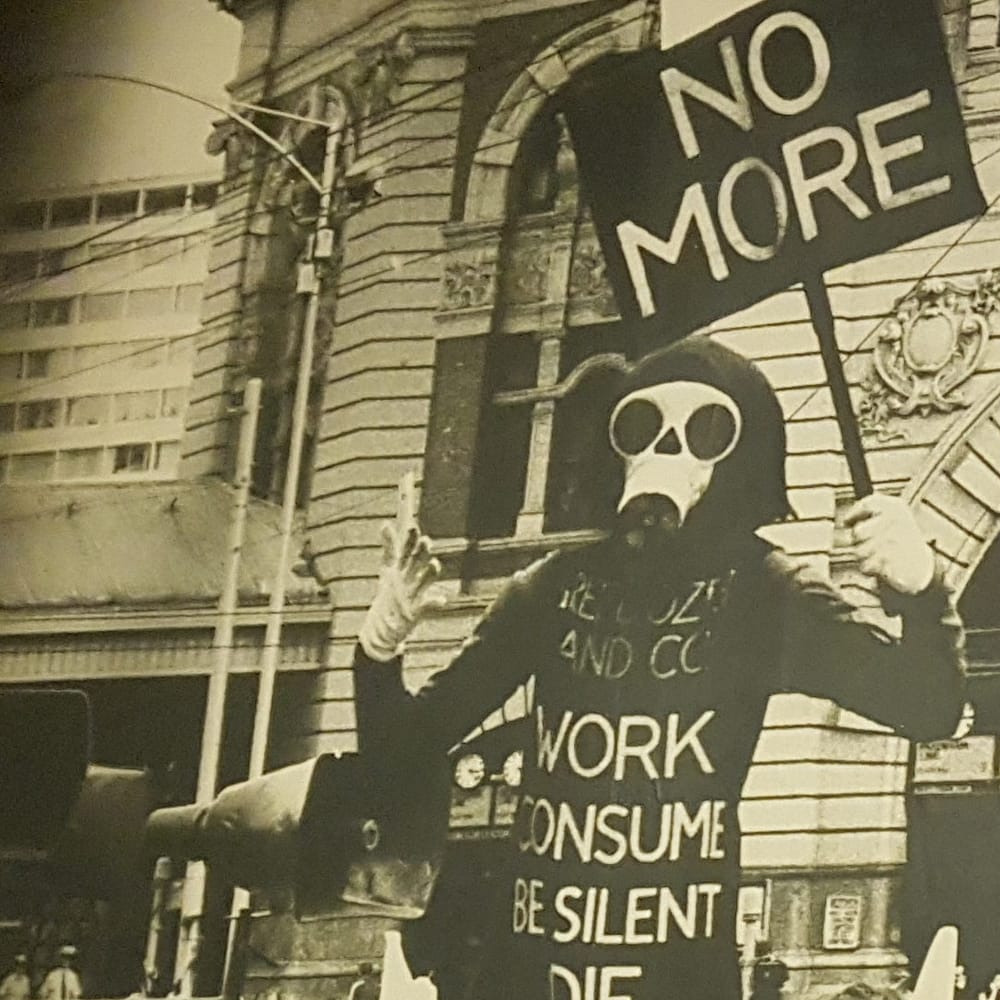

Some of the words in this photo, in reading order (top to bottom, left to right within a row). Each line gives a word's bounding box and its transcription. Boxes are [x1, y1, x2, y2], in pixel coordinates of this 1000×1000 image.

[660, 10, 831, 159] NO
[616, 89, 951, 318] MORE
[536, 706, 715, 781] WORK
[513, 878, 544, 935] BE
[553, 884, 721, 945] SILENT
